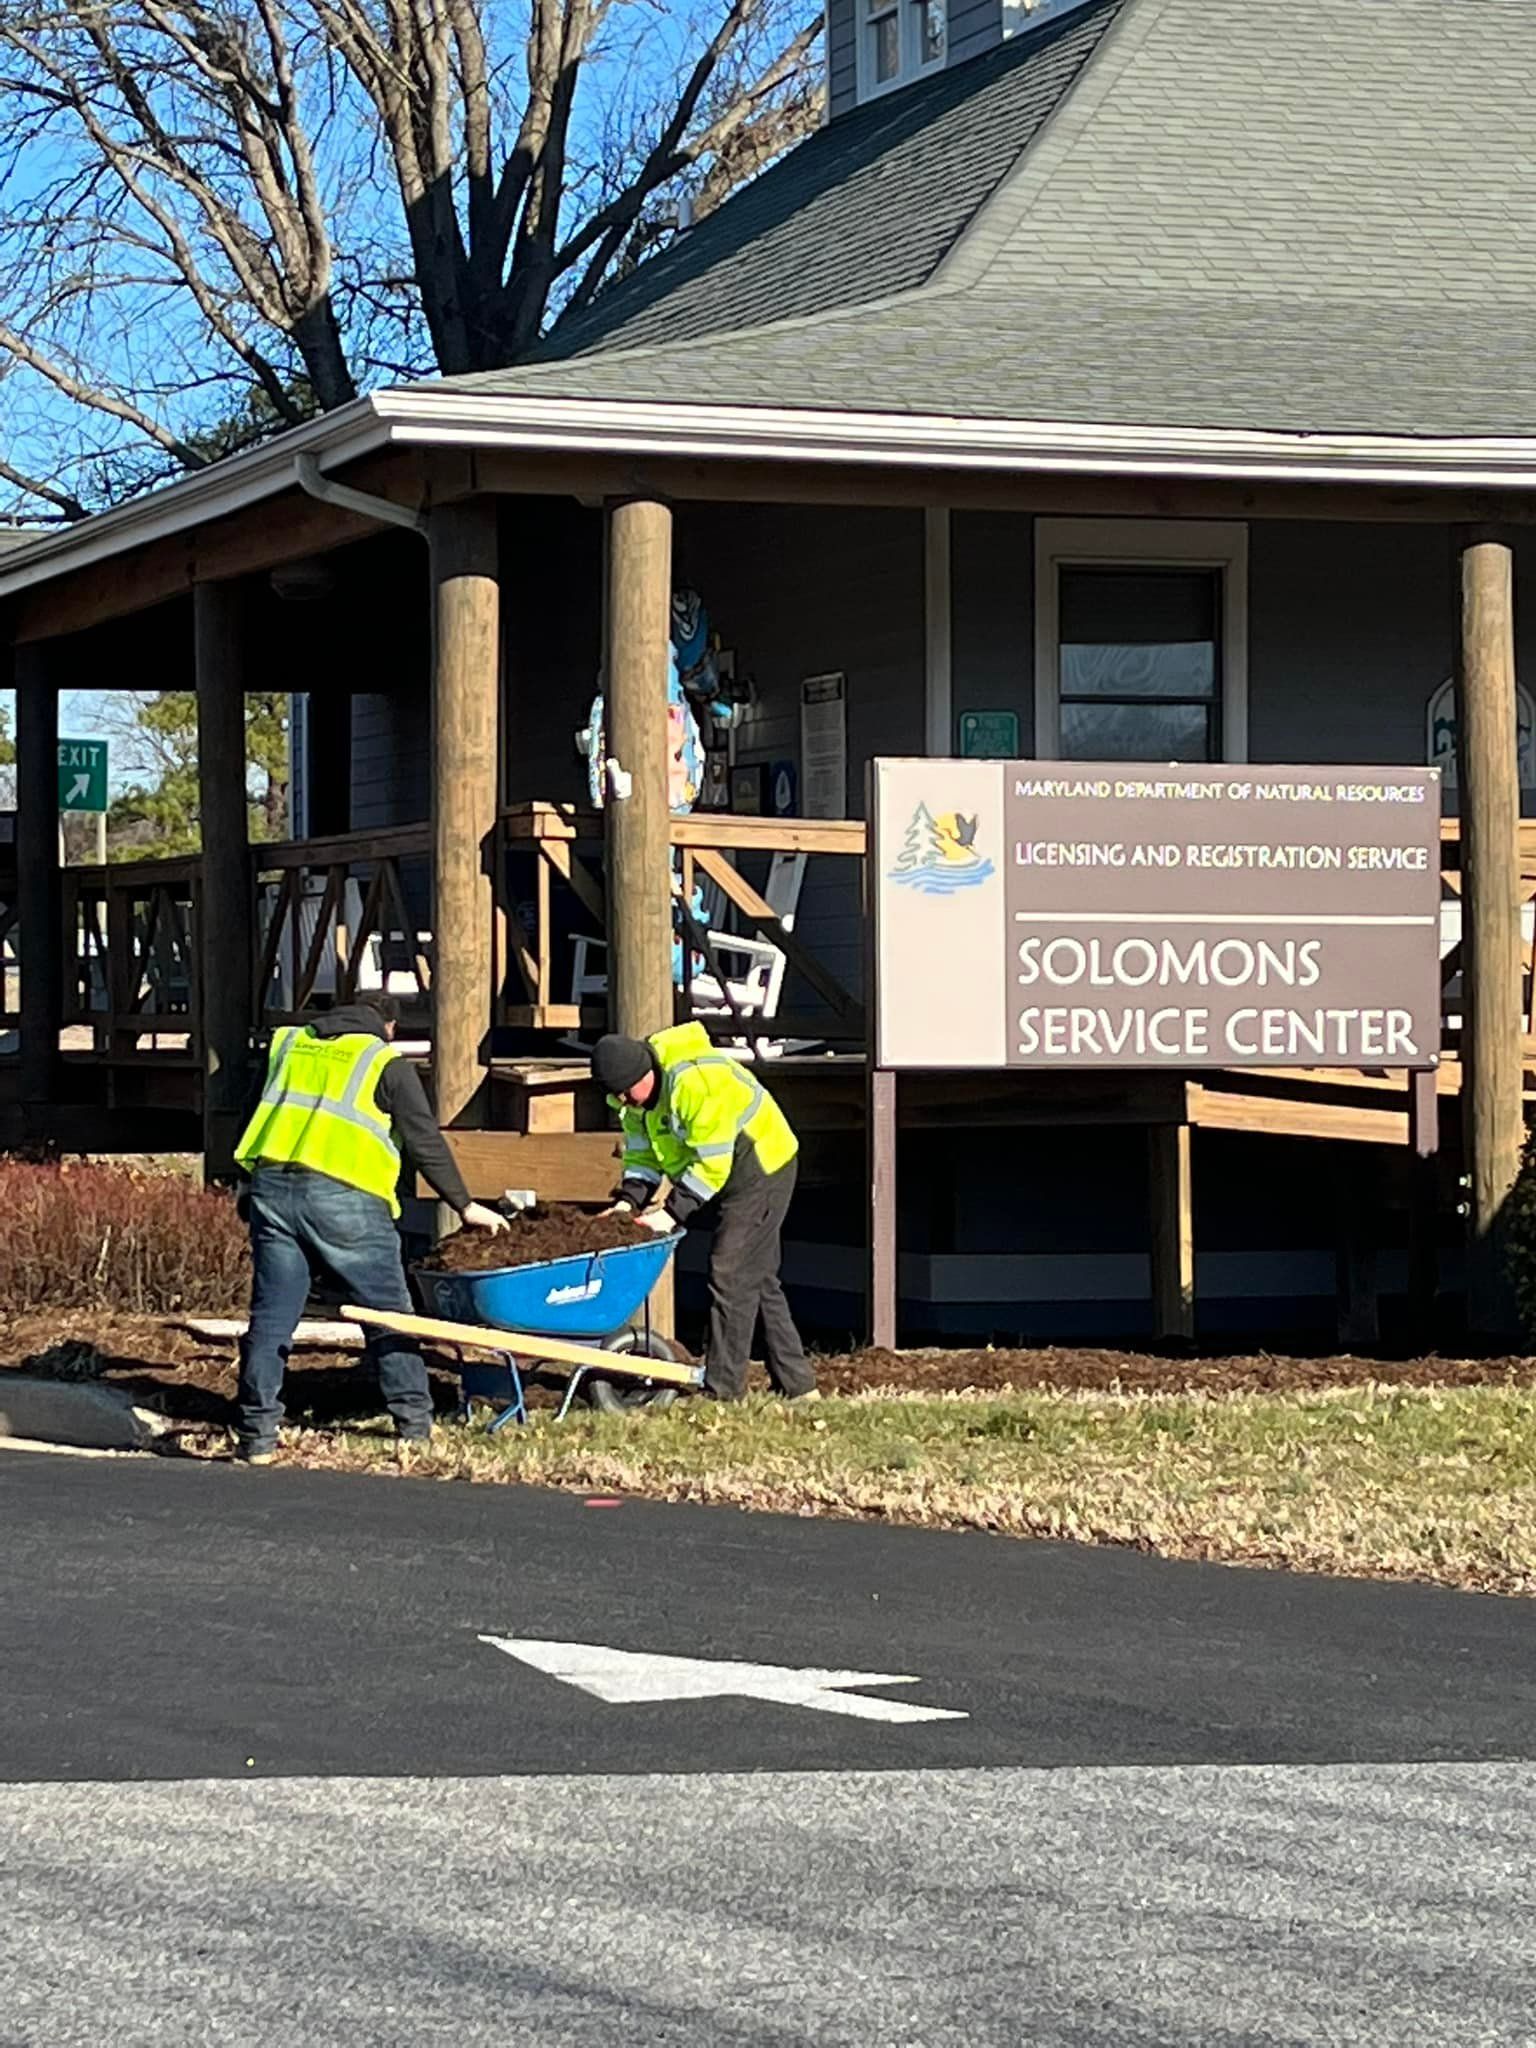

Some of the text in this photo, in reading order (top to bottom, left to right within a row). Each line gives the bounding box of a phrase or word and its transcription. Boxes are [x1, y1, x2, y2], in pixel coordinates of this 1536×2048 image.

[57, 744, 100, 767] EXIT
[1015, 779, 1424, 802] MARYLAND DEPARTMENT OF NATURAL RESOURCES
[1015, 842, 1427, 869] LICENSING AND REGISTRATION SERVICE
[1018, 938, 1321, 986] SOLOMONS
[1018, 1007, 1418, 1055] SERVICE CENTER
